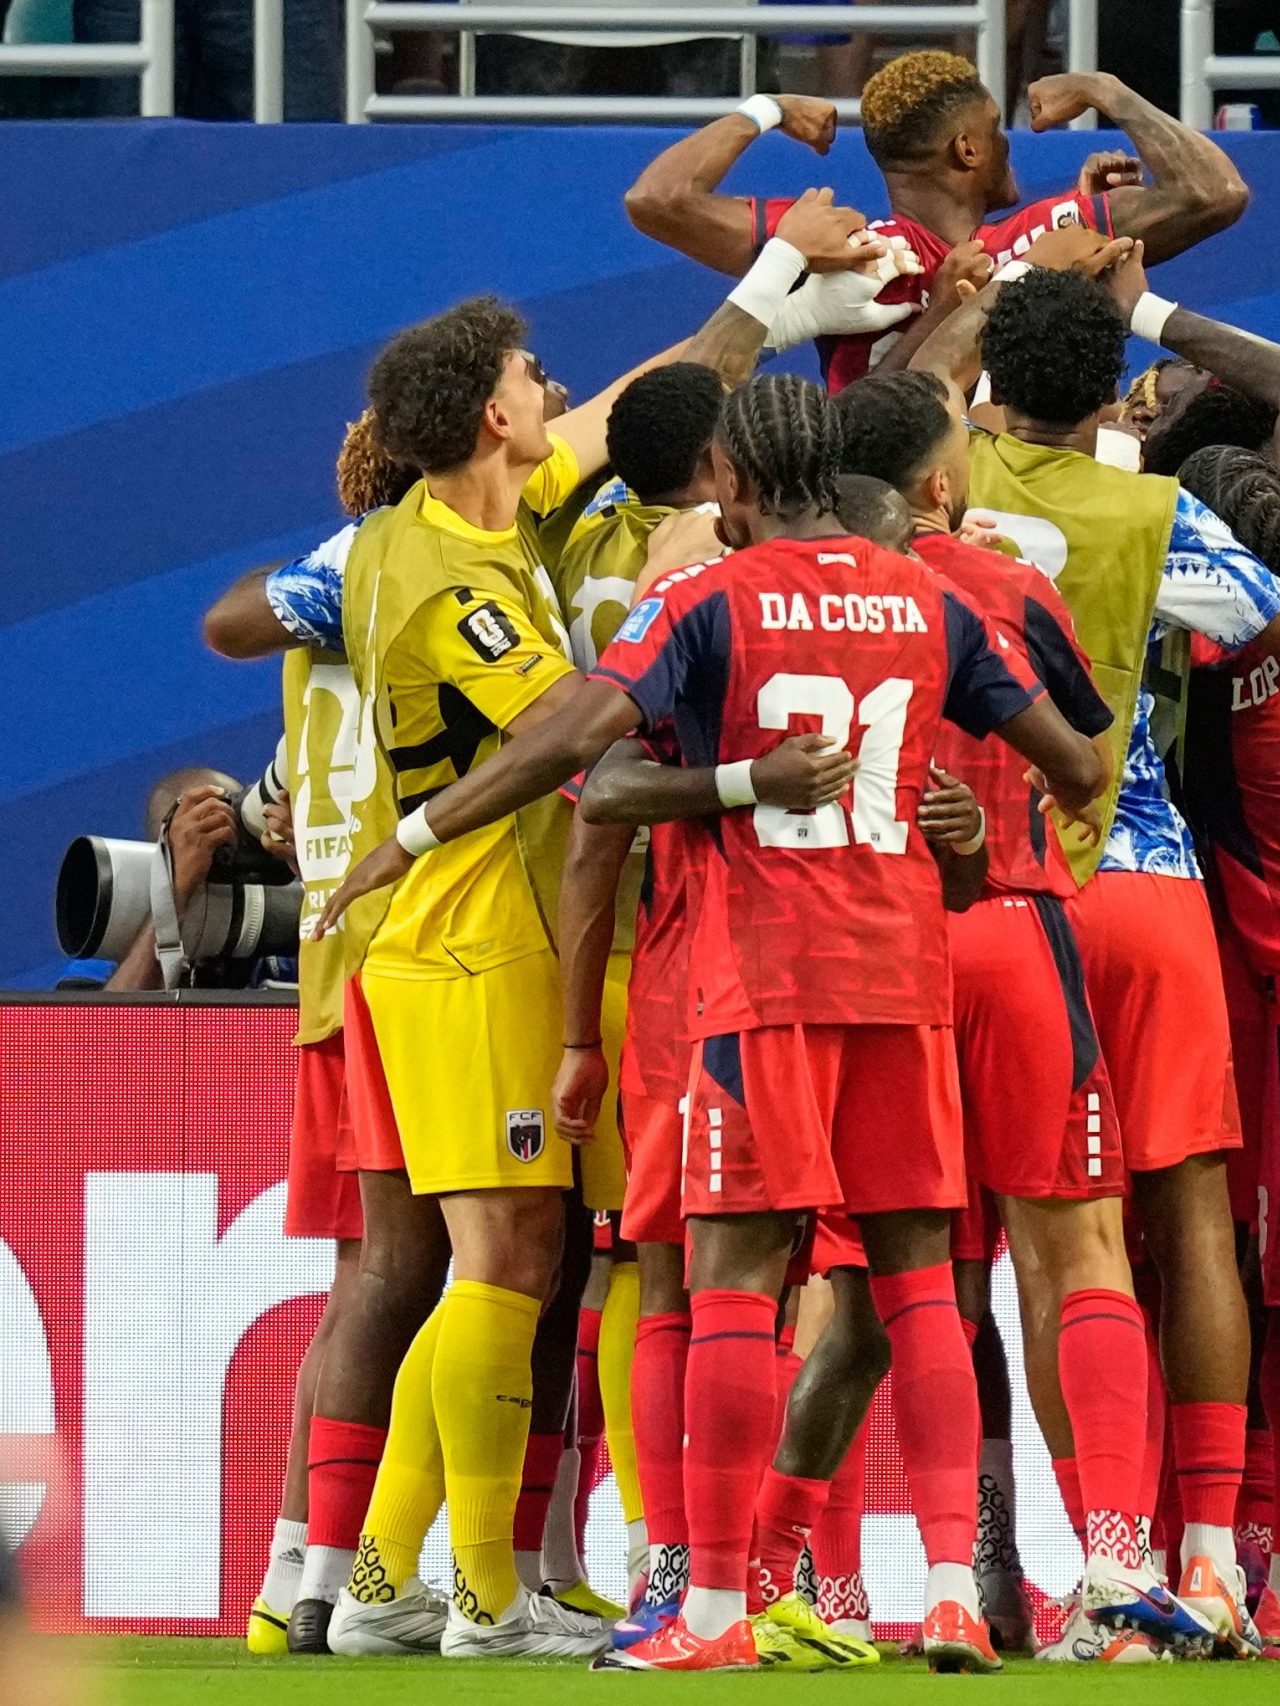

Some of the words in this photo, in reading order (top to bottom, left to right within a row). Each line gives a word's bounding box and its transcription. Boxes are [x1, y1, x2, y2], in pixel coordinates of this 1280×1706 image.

[758, 592, 814, 631] DA
[819, 594, 928, 634] COSTA
[752, 673, 914, 855] 21
[306, 836, 351, 861] FIFA
[509, 1112, 542, 1121] FCF
